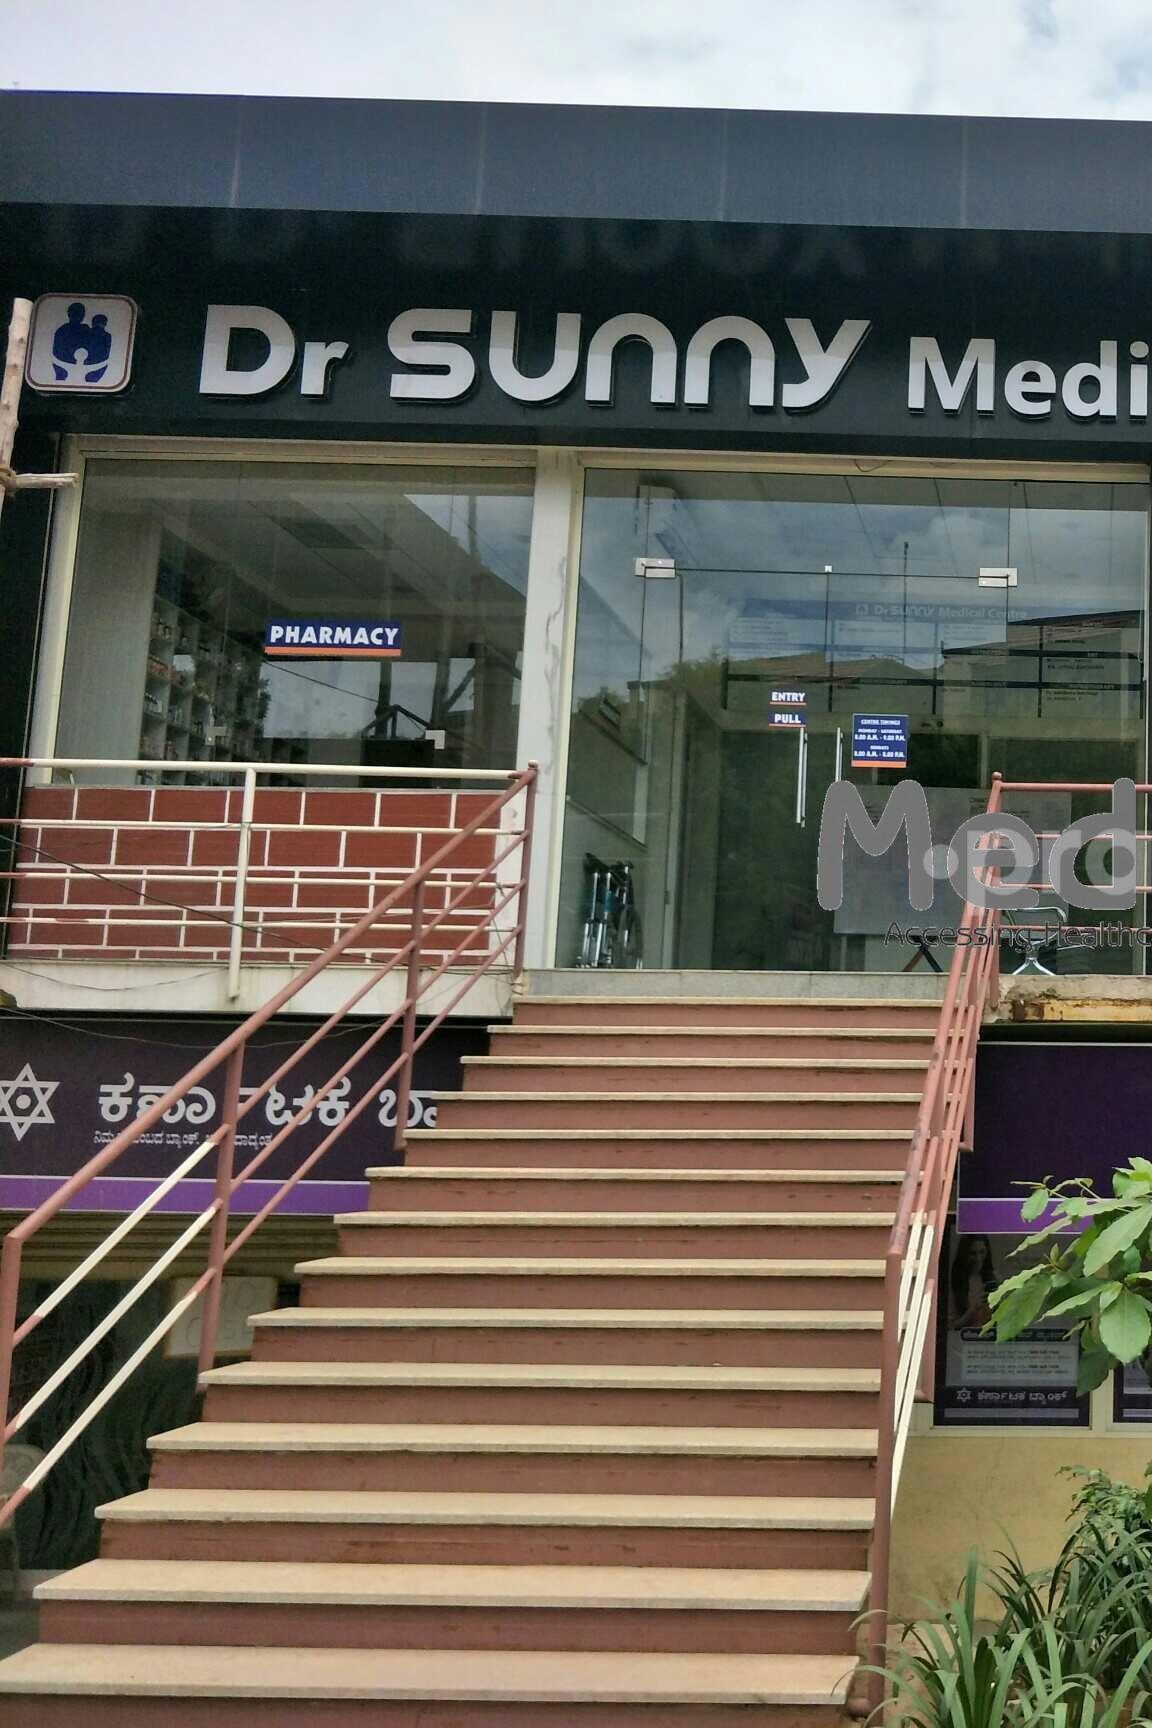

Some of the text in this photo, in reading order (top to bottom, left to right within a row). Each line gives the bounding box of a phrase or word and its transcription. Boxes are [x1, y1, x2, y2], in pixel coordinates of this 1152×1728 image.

[199, 304, 349, 396] Dr
[270, 625, 399, 646] PHARMACY
[771, 691, 805, 702] ENTRY
[774, 713, 801, 724] PULL
